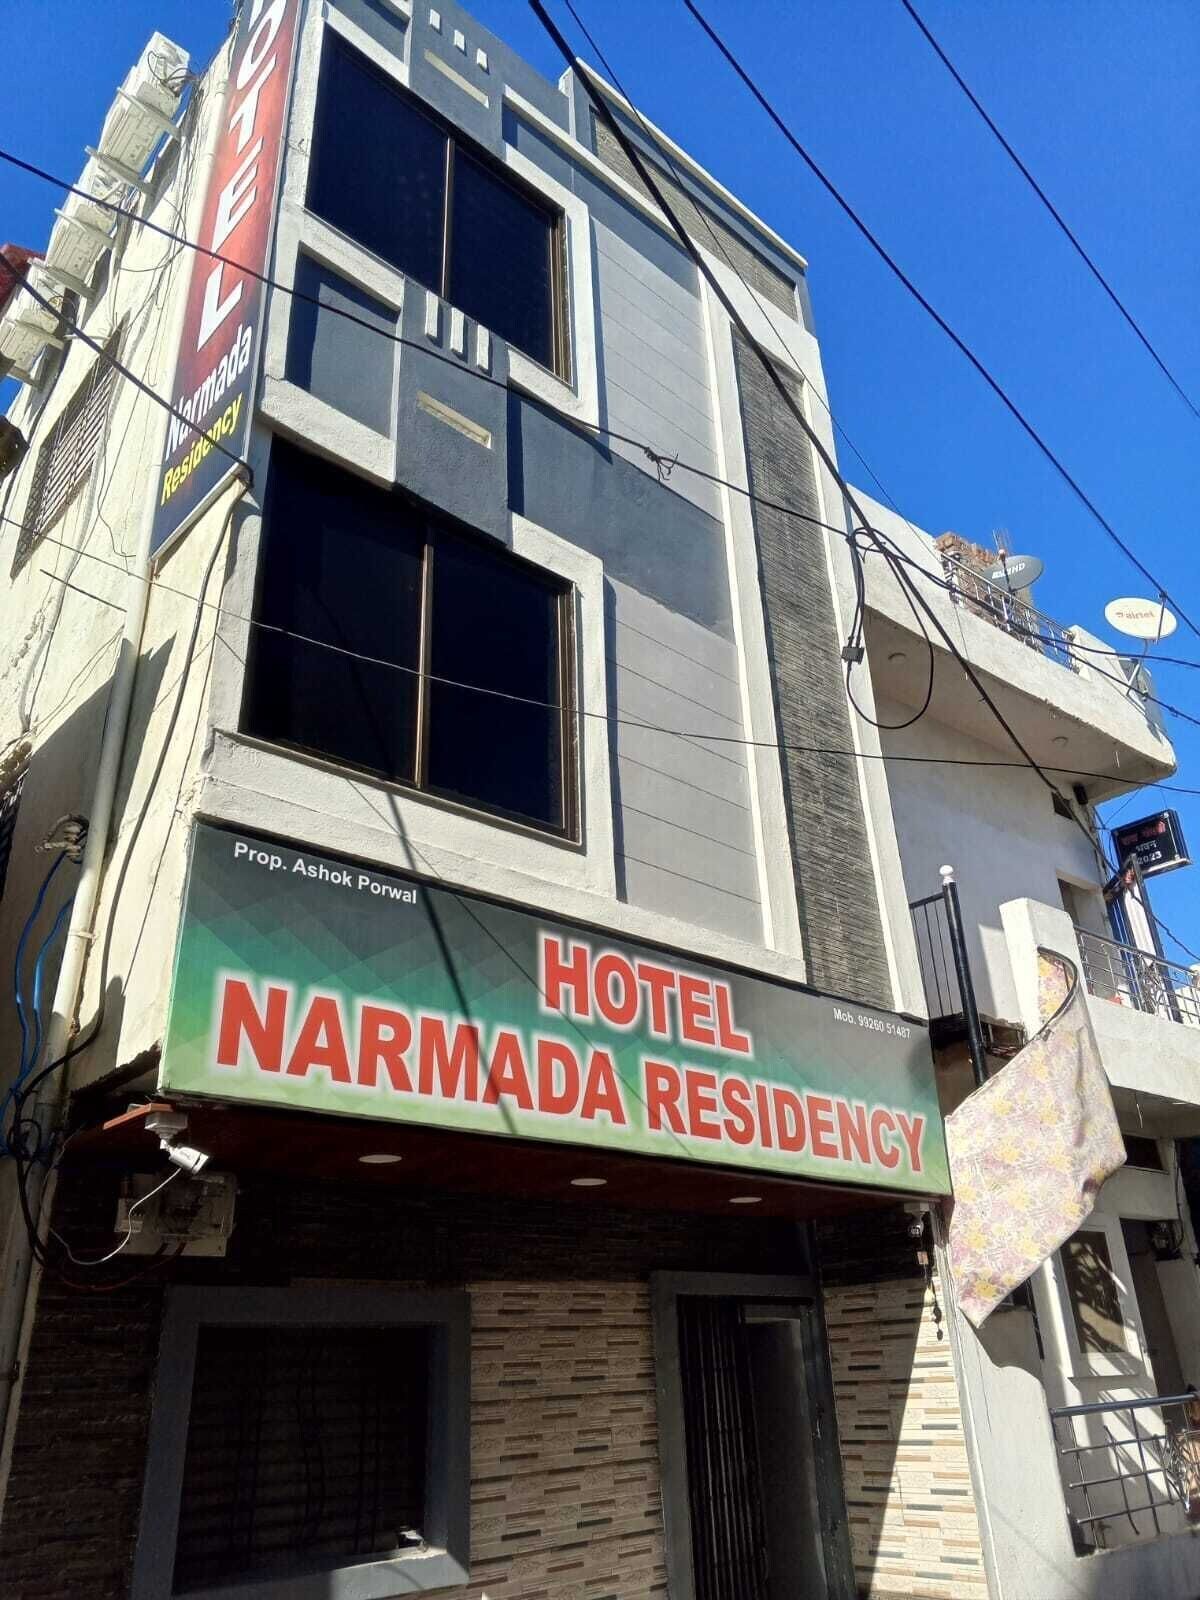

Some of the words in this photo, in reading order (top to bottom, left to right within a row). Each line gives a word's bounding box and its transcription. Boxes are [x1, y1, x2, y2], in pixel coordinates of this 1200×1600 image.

[196, 0, 287, 352] OTEL
[161, 392, 242, 506] Residency
[165, 324, 252, 461] Narmada
[234, 841, 287, 870] Prop.
[292, 858, 353, 888] Ashok
[358, 875, 417, 904] Porwal
[1136, 850, 1162, 865] 2023
[543, 937, 749, 1053] HOTEL
[833, 1007, 857, 1025] Mob.
[858, 1015, 884, 1032] 99260
[216, 978, 627, 1126] NARMADA
[644, 1060, 924, 1172] RESIDENCY
